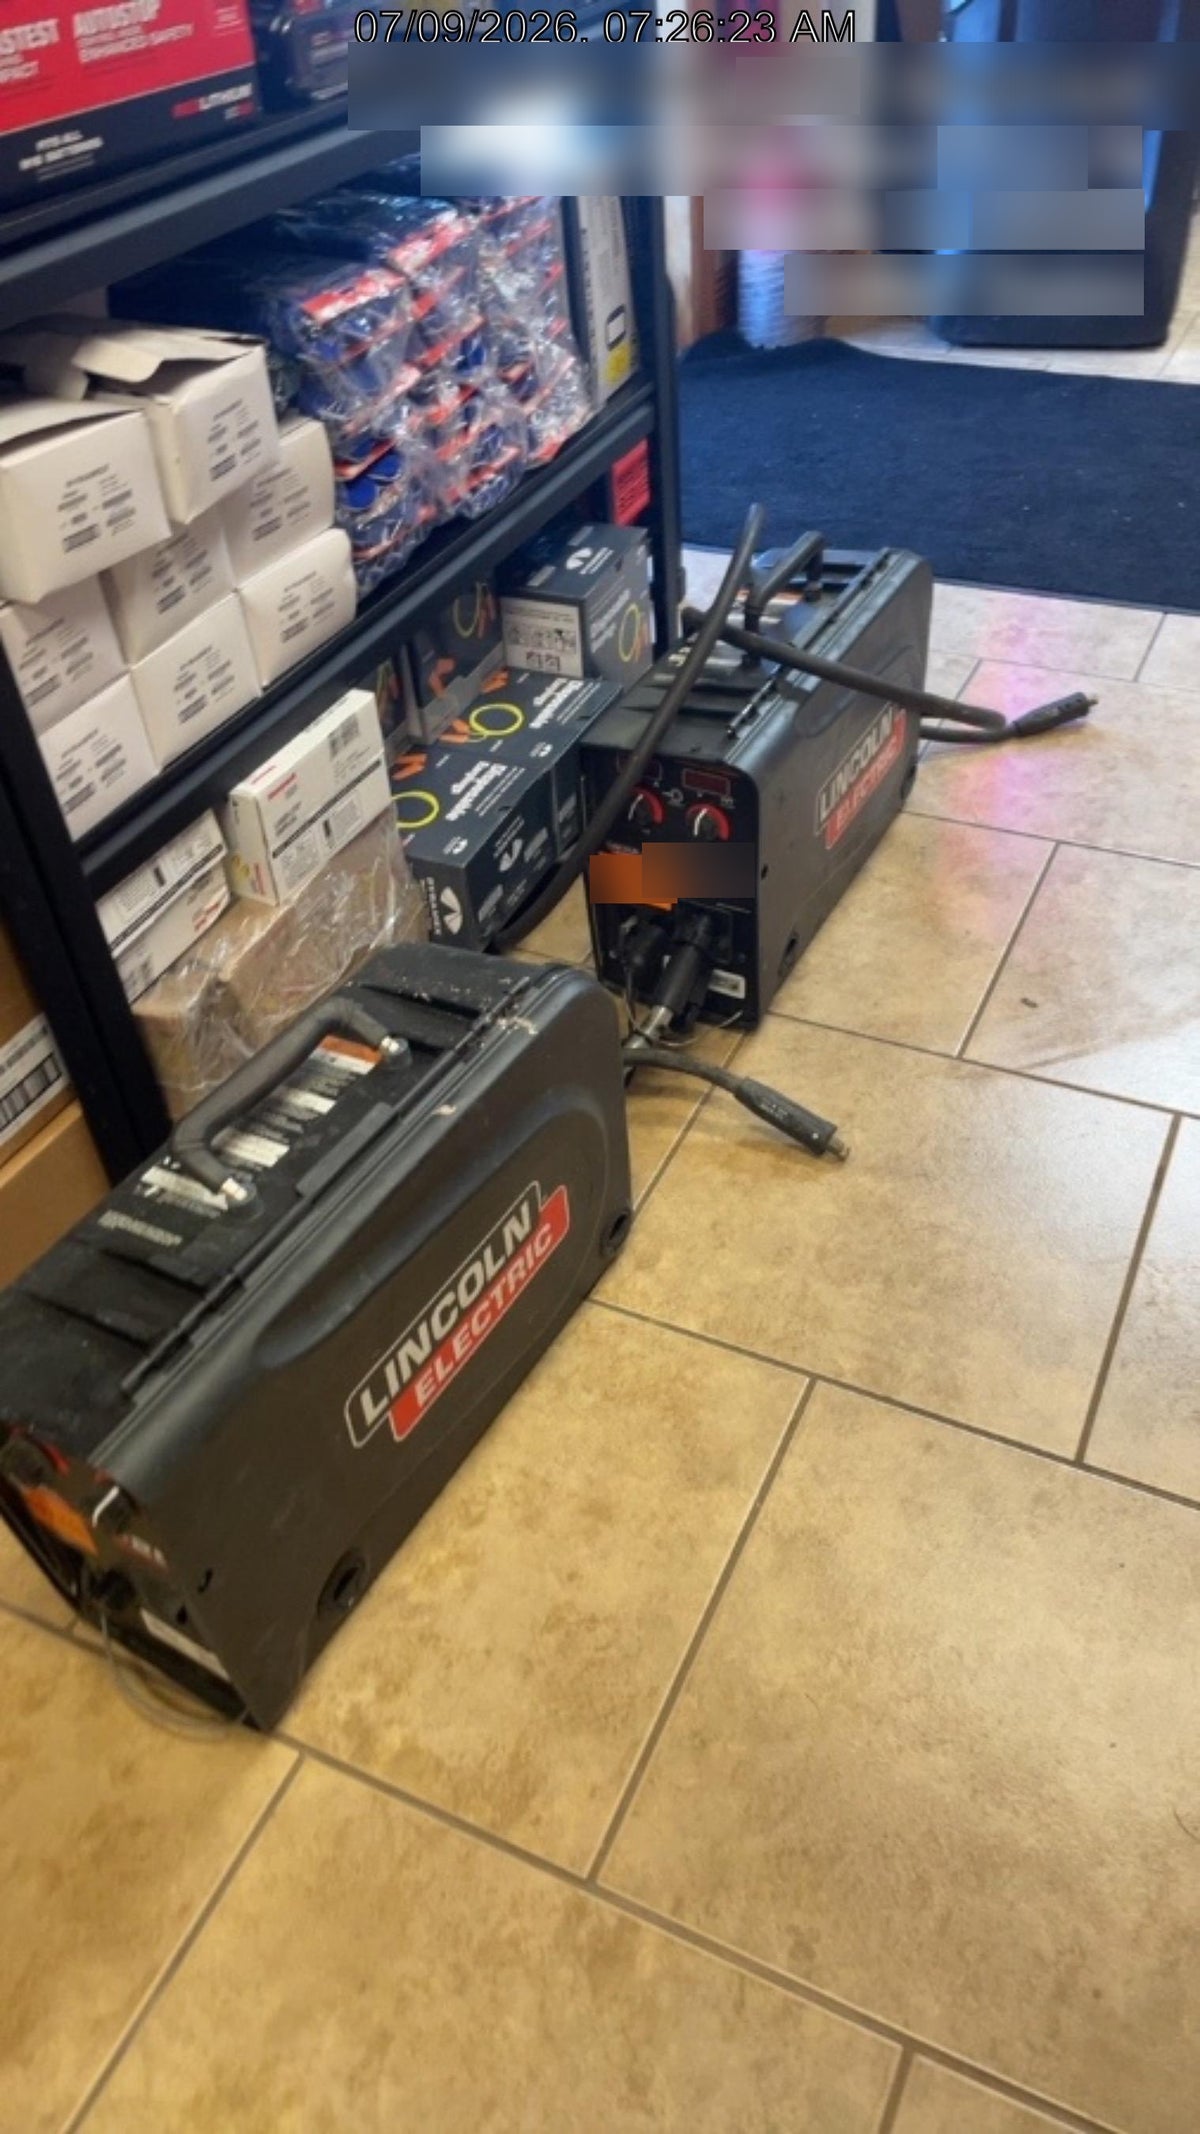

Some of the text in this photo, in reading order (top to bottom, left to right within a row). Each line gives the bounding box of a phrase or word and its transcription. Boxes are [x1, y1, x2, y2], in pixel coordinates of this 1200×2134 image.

[820, 707, 893, 823] LINCOLN
[359, 1201, 532, 1427] LINCOLN
[413, 1222, 552, 1408] ELECTRIC
